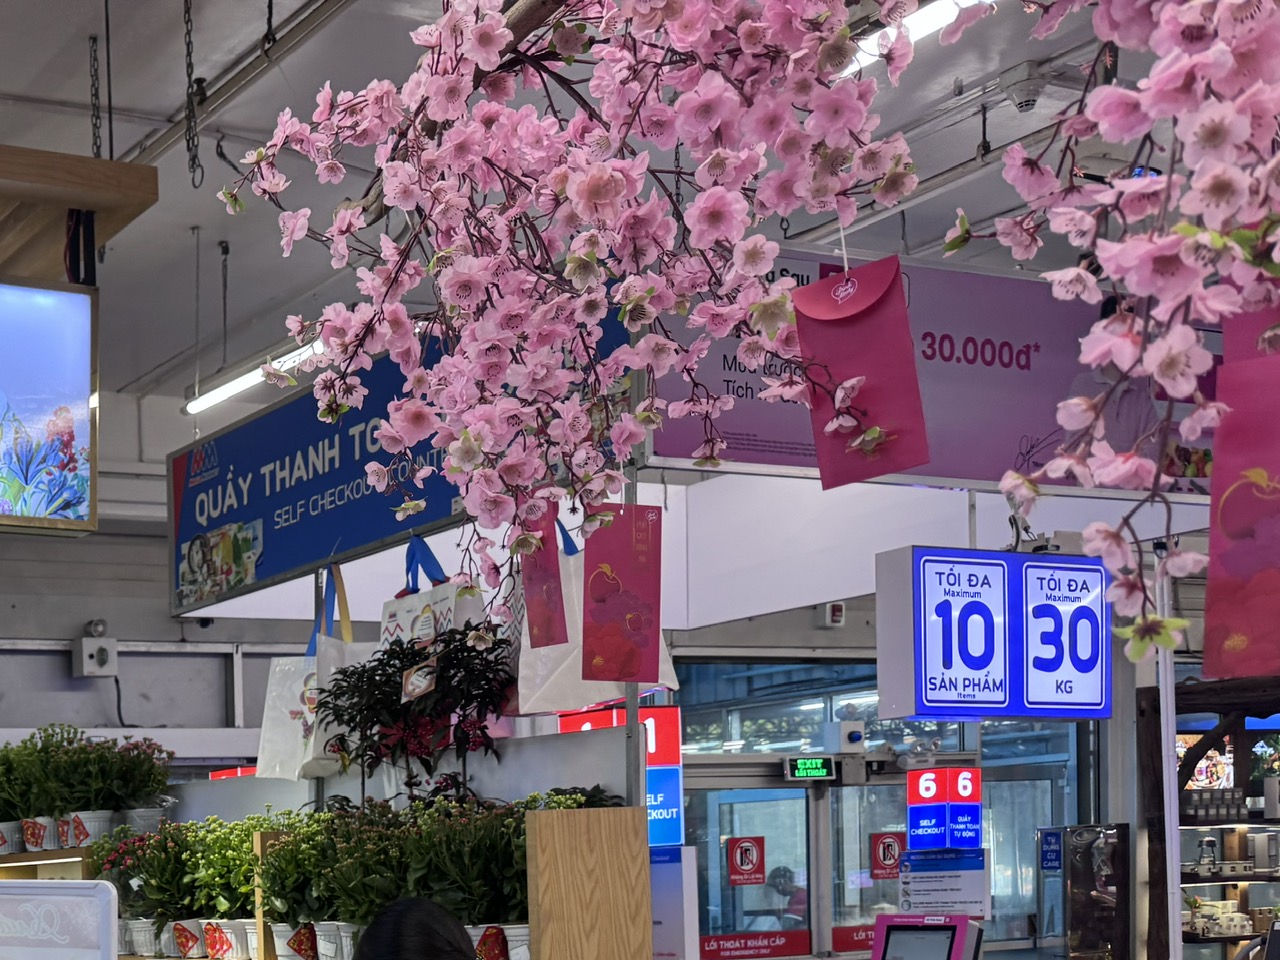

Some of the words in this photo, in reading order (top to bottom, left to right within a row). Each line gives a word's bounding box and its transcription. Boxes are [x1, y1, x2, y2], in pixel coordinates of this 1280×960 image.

[195, 464, 254, 528] QUẦY
[260, 433, 341, 497] THANH
[348, 417, 383, 461] TO
[274, 499, 307, 530] SELF
[309, 476, 374, 517] CHECKOU
[935, 565, 962, 587] TỐI
[967, 573, 992, 589] ĐA
[1036, 570, 1062, 591] TỐI
[1067, 579, 1091, 593] ĐA
[943, 588, 982, 599] Maximum
[1045, 592, 1082, 604] Maximum
[934, 599, 995, 671] 10
[1032, 603, 1100, 674] 30
[928, 671, 959, 693] SẢN
[1055, 679, 1073, 695] KG
[957, 692, 976, 700] Items
[797, 758, 823, 769] EXIT
[918, 772, 937, 798] 6
[957, 771, 973, 797] 6
[646, 793, 665, 806] ELF
[910, 826, 946, 836] CHECKOUT
[919, 818, 937, 827] SELF
